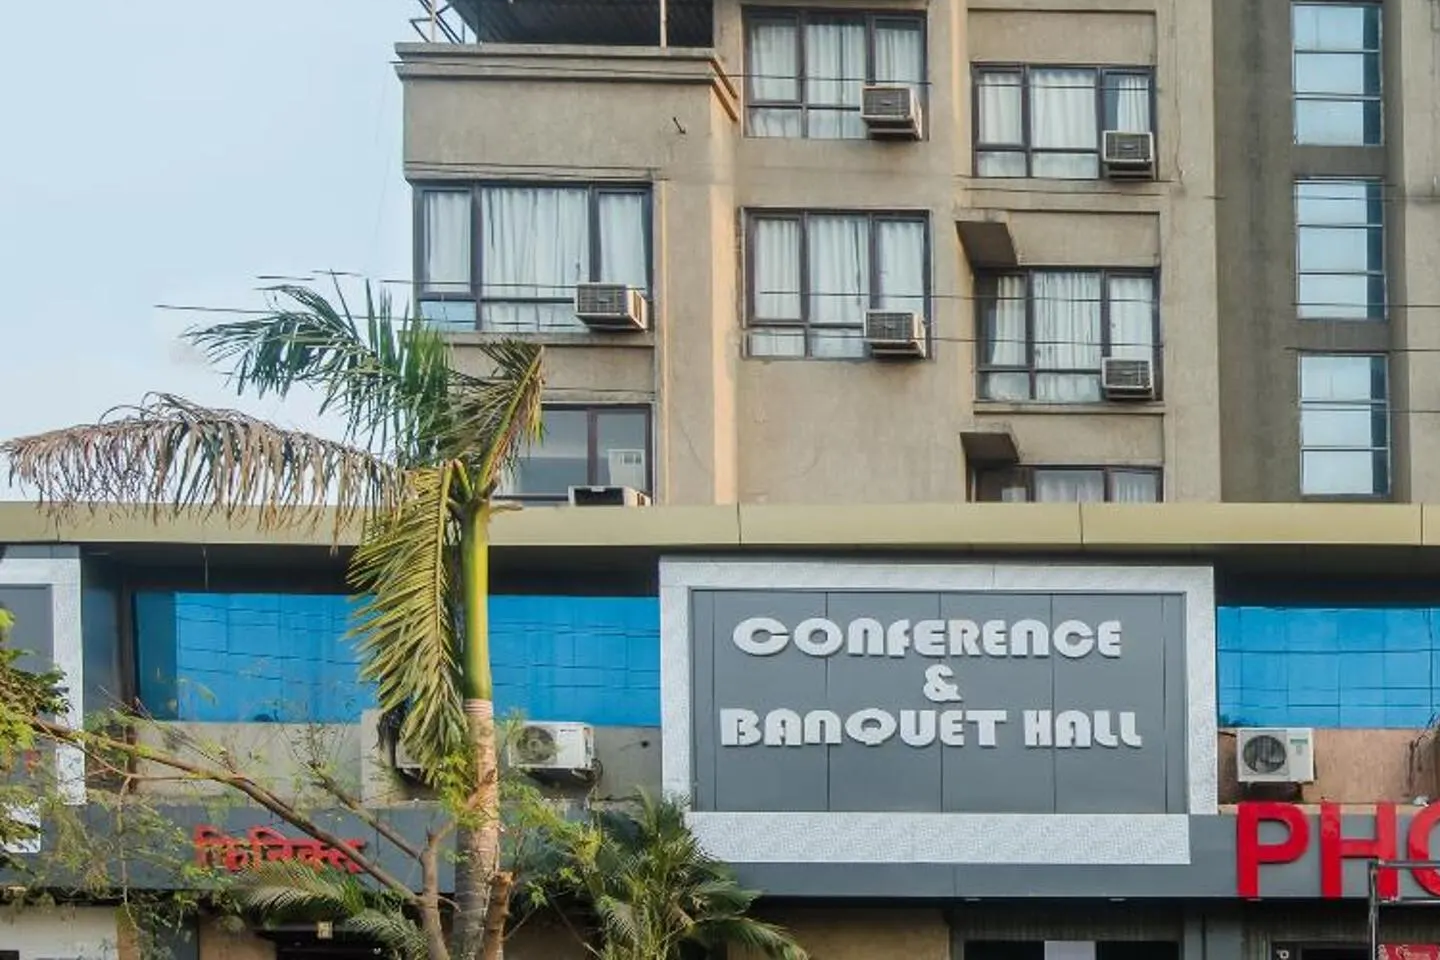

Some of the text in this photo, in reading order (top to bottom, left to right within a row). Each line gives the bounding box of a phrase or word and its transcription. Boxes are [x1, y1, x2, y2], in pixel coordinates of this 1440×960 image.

[732, 616, 1122, 658] CONFERENCE
[922, 663, 963, 702] &
[719, 707, 1143, 748] BANQUET HALL
